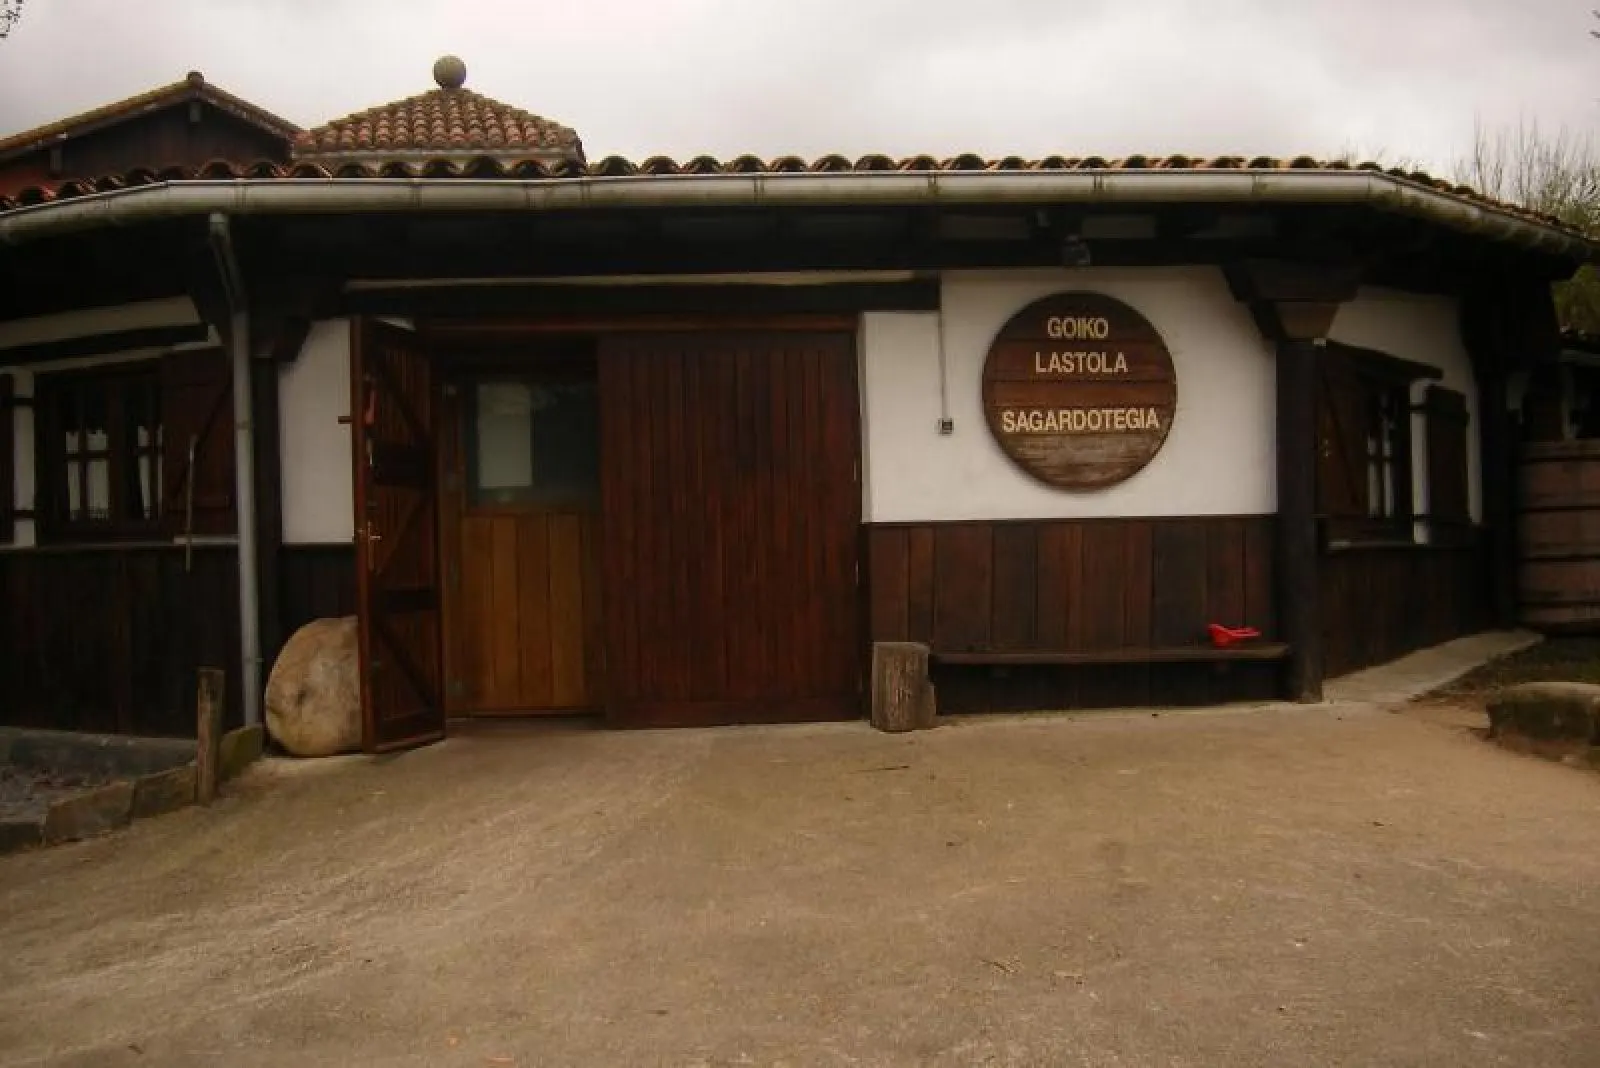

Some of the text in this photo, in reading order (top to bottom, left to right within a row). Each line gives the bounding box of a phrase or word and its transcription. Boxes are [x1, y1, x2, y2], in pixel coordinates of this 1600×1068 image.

[1047, 316, 1109, 339] GOIKO
[1035, 351, 1129, 373] LASTOLA
[1002, 408, 1160, 433] SAGARDOTEGIA
